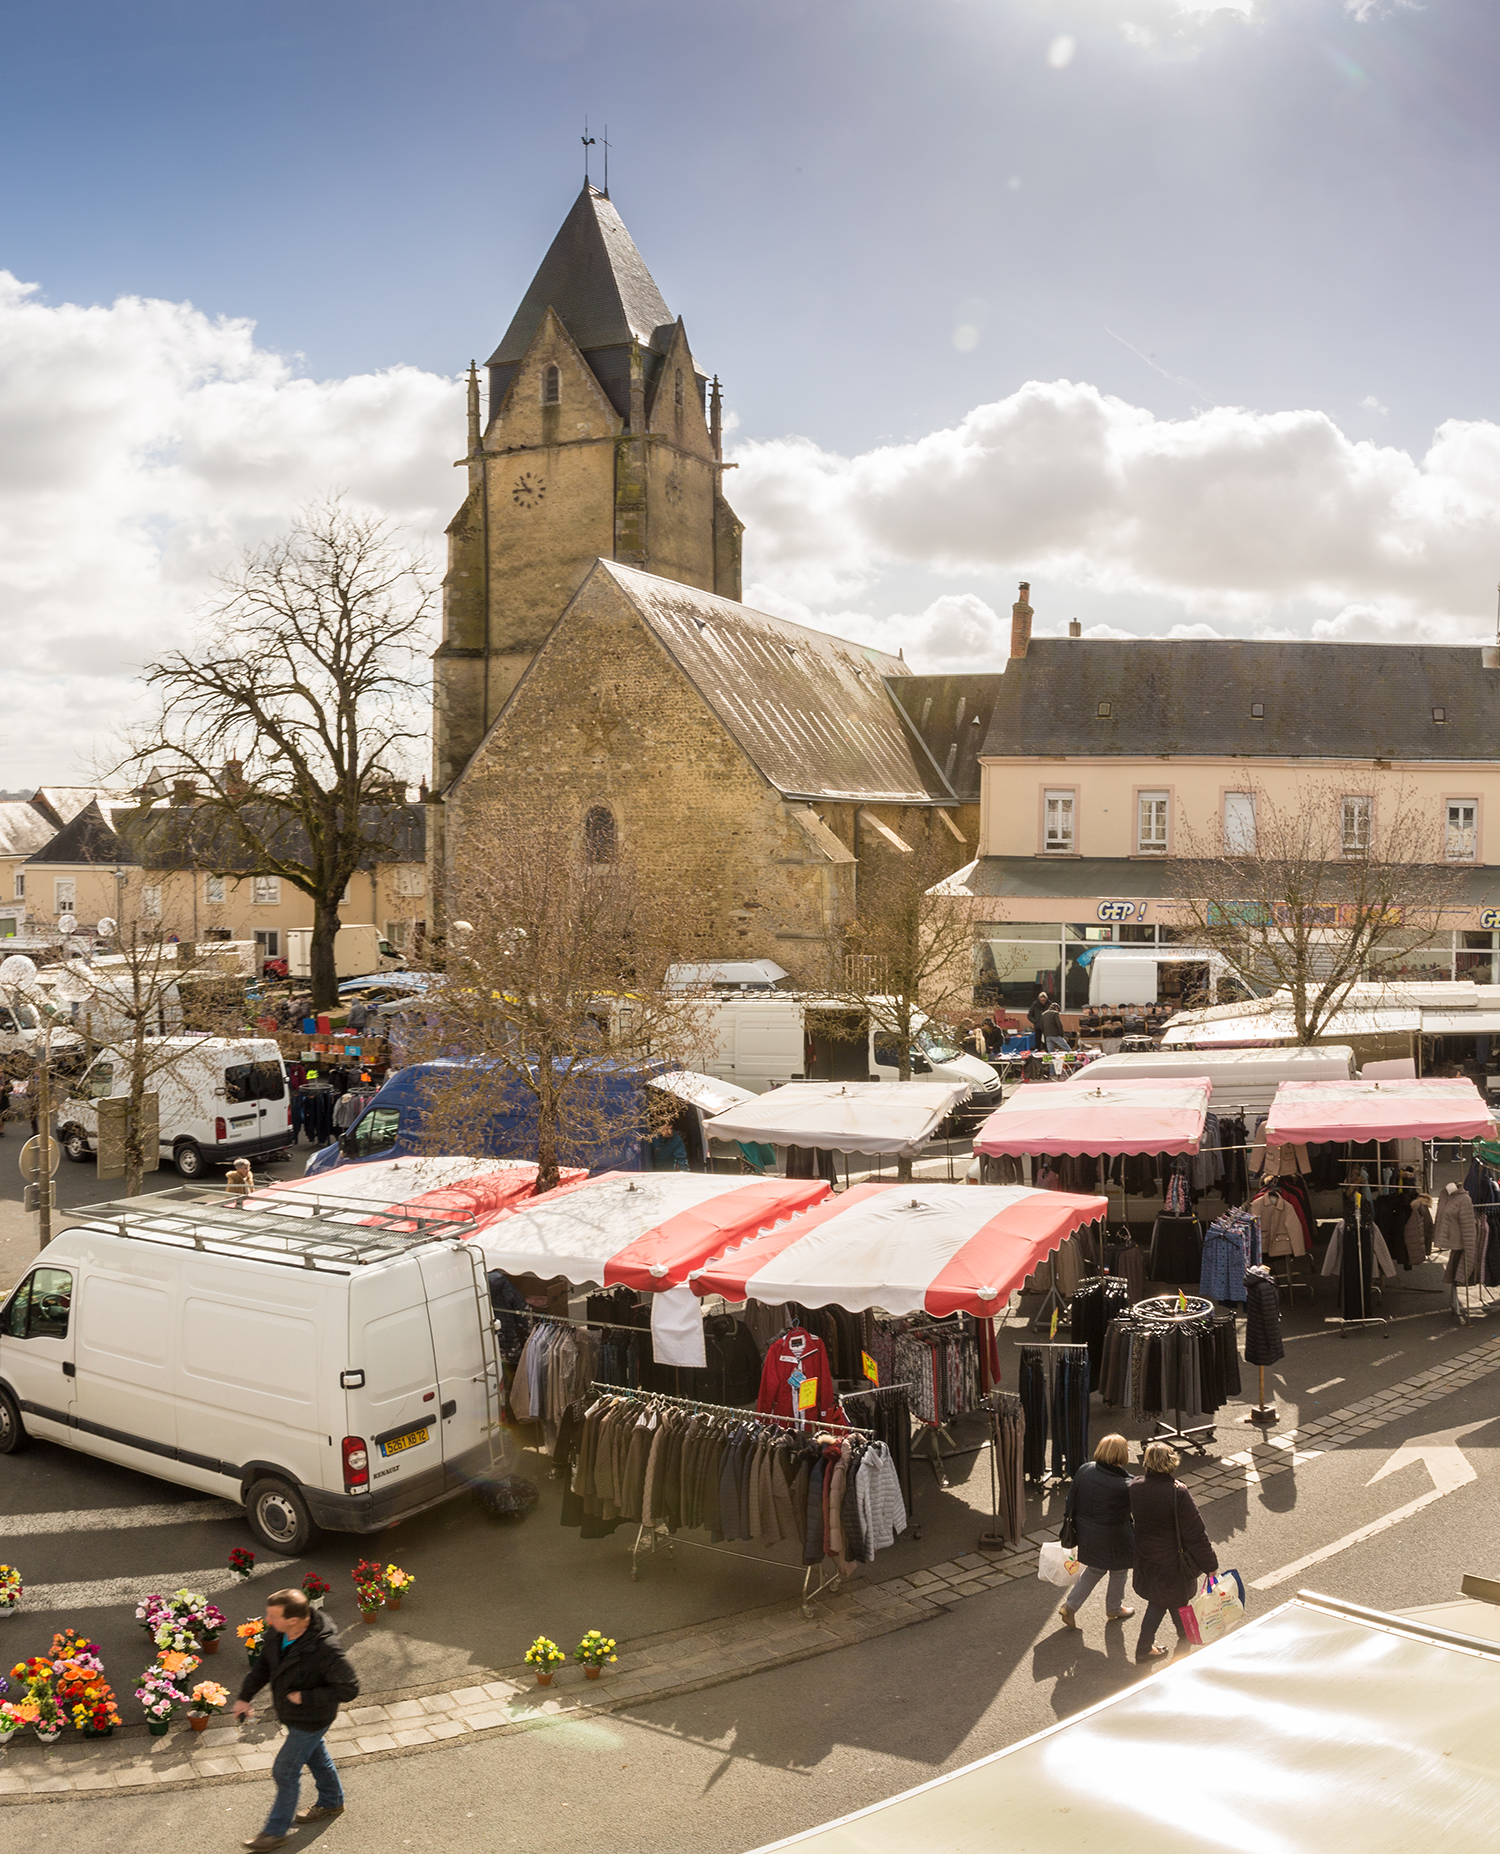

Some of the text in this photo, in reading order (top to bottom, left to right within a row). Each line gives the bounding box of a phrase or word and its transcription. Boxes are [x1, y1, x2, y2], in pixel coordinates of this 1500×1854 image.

[387, 1438, 407, 1453] 5261
[417, 1430, 427, 1441] 72
[373, 1465, 400, 1479] RENAULT
